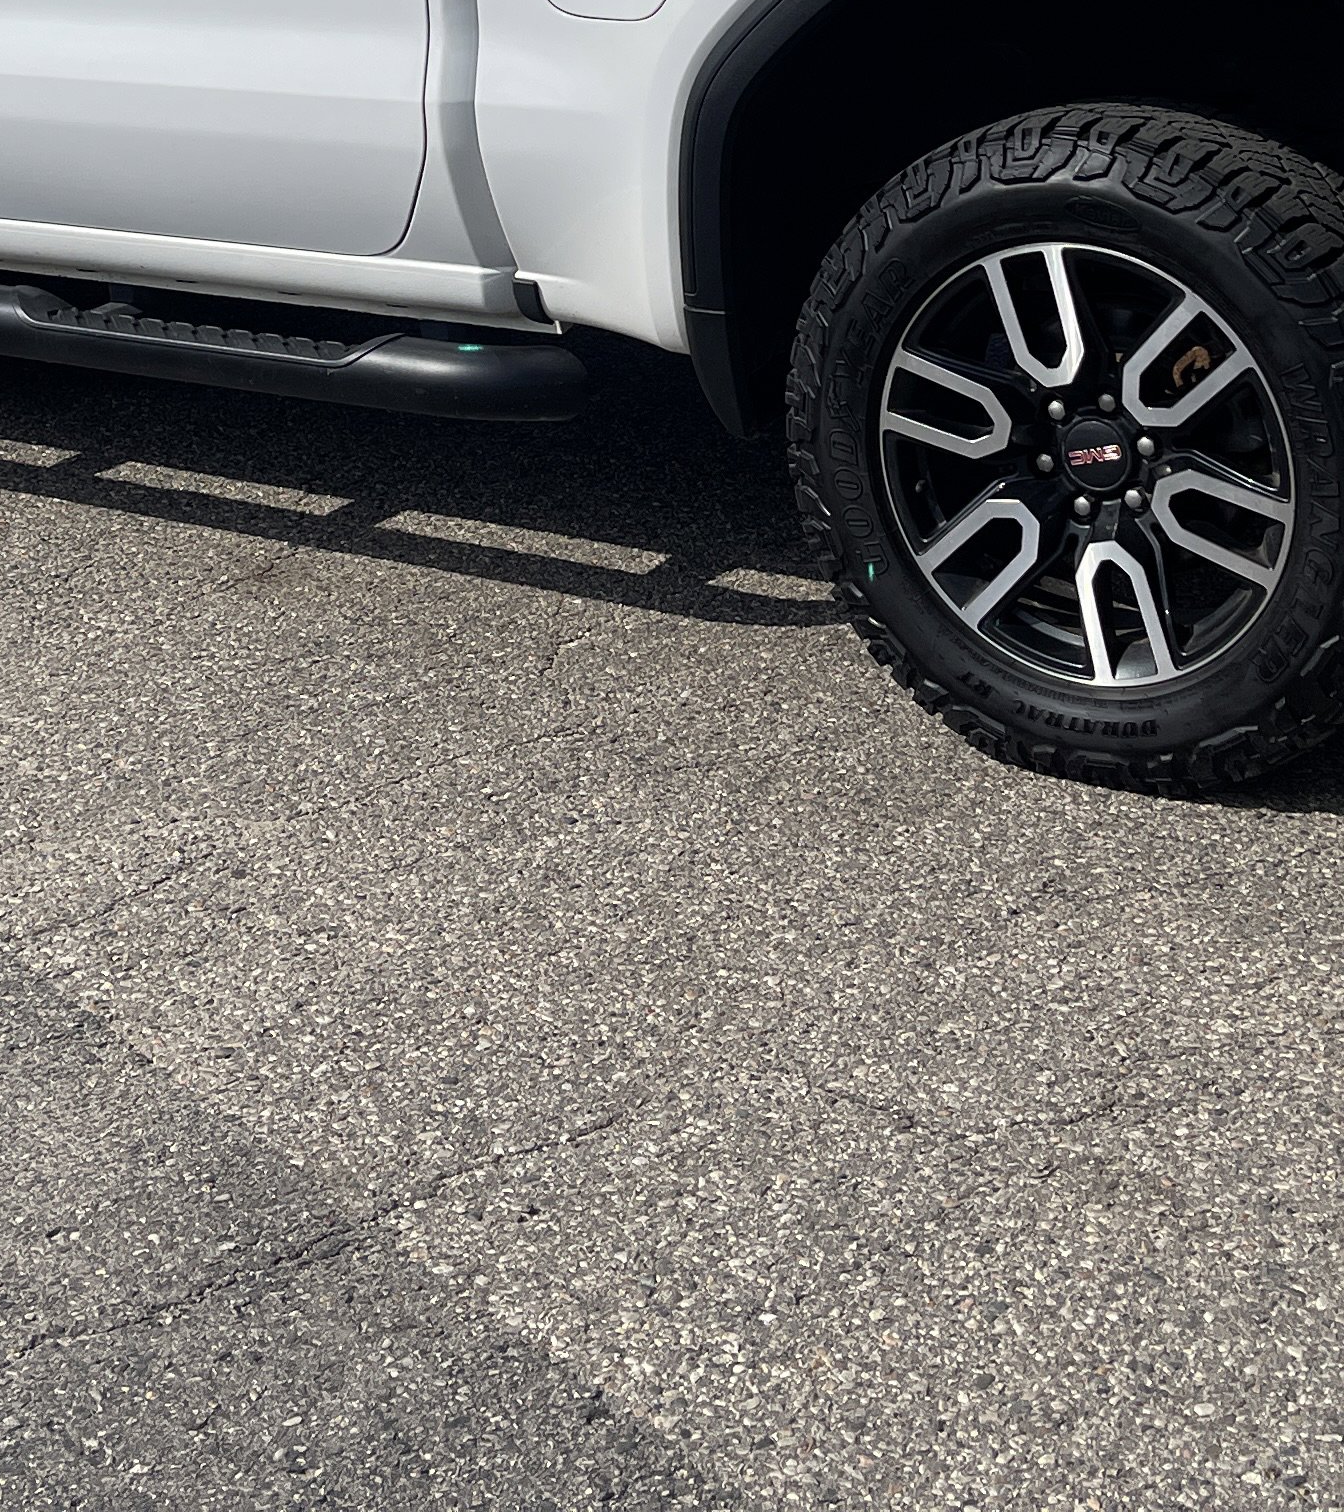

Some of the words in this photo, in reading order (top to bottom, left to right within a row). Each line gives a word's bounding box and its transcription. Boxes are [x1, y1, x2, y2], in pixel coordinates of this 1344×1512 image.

[827, 255, 915, 578] GOODYEAR
[1068, 444, 1122, 466] GMC
[1252, 362, 1343, 684] WRANGLER
